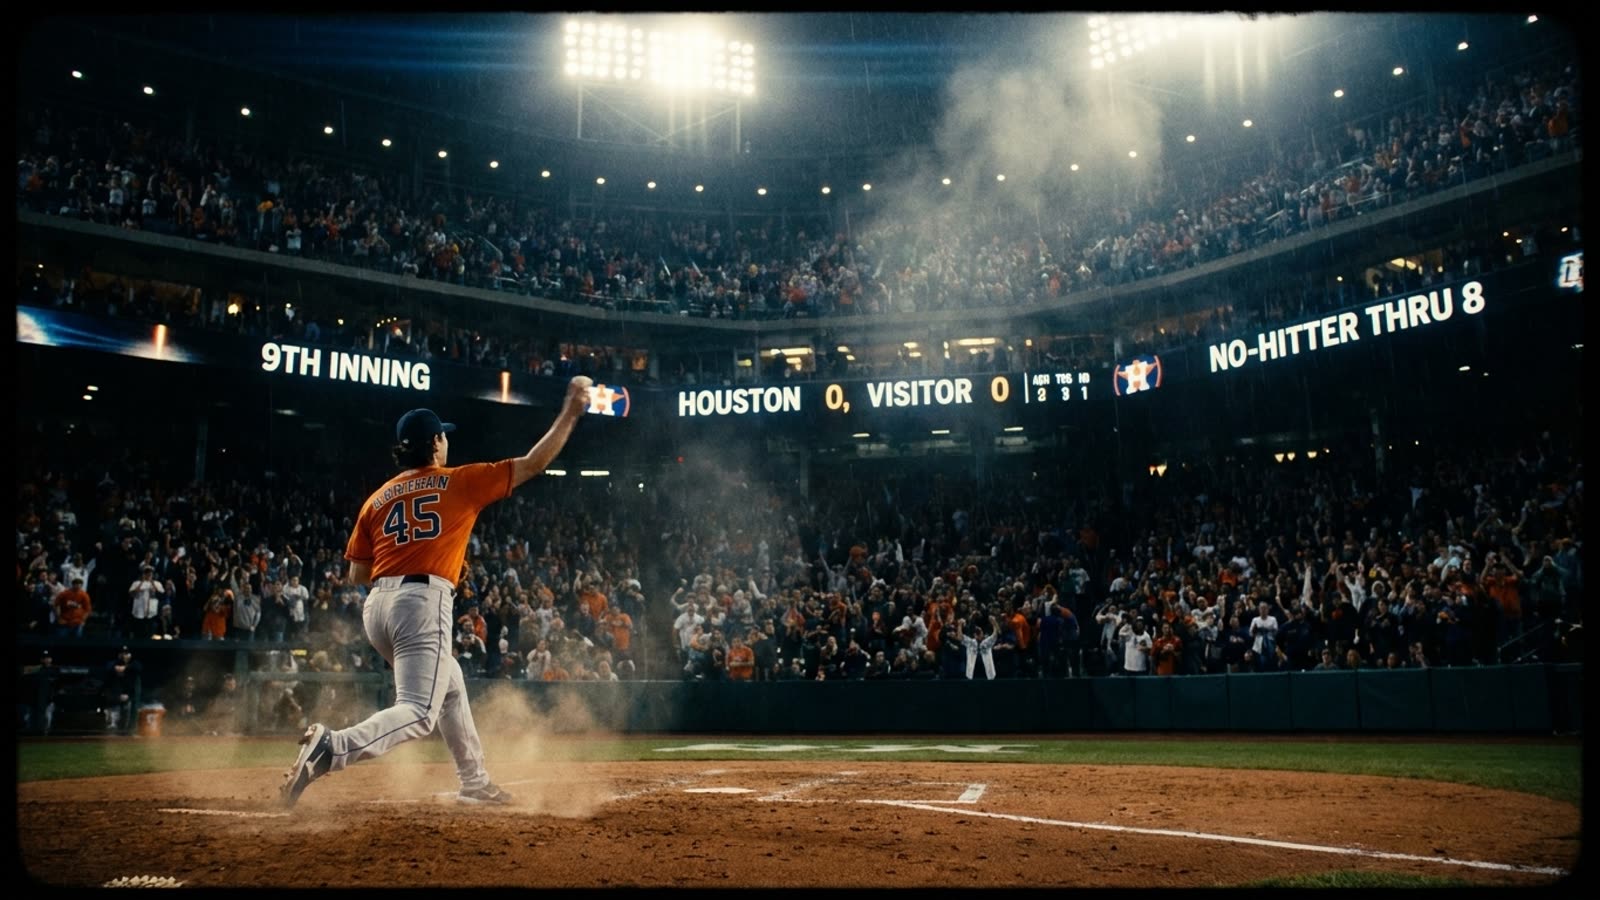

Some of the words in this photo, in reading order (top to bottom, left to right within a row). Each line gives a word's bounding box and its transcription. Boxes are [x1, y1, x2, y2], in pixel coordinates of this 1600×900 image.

[1208, 311, 1360, 373] NO-HITTER
[1364, 287, 1453, 336] THRU
[1461, 281, 1486, 315] 8
[261, 342, 322, 377] 9TH
[329, 351, 431, 391] INNING
[678, 386, 801, 417] HOUSTON
[825, 383, 850, 414] 0,
[866, 378, 973, 408] VISITOR
[990, 376, 1010, 403] 0
[1037, 387, 1047, 402] 2
[1061, 386, 1070, 401] 3
[1080, 386, 1088, 400] 1
[382, 493, 442, 546] 45
